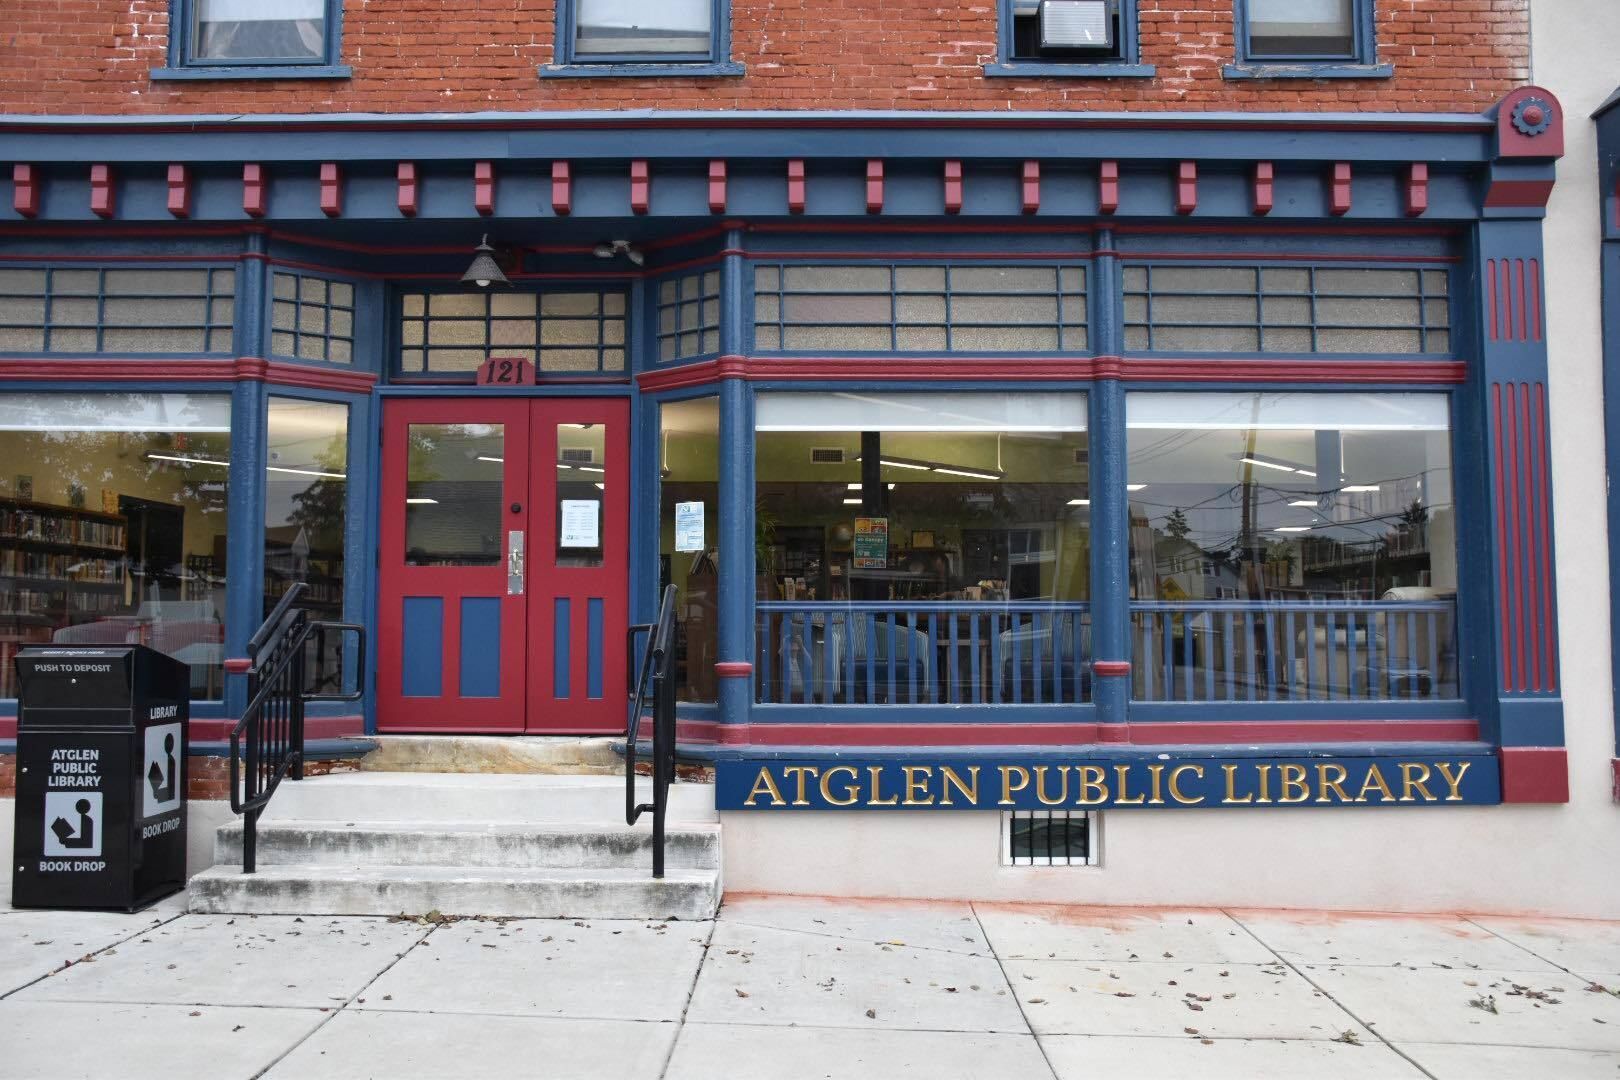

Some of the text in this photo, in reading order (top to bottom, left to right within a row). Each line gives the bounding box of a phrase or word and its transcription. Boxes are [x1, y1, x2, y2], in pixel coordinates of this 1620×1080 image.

[486, 361, 524, 383] 121
[34, 664, 111, 672] PUSH TO DEPOSIT
[150, 705, 178, 720] LIBRARY
[51, 750, 99, 761] ATGLEN
[53, 763, 97, 774] PUBLIC
[48, 776, 101, 787] LIBRARY
[743, 761, 1471, 806] ATGLEN PUBLIC LIBRARY
[142, 817, 180, 839] BOOK DROP
[39, 862, 106, 872] BOOK DROP
